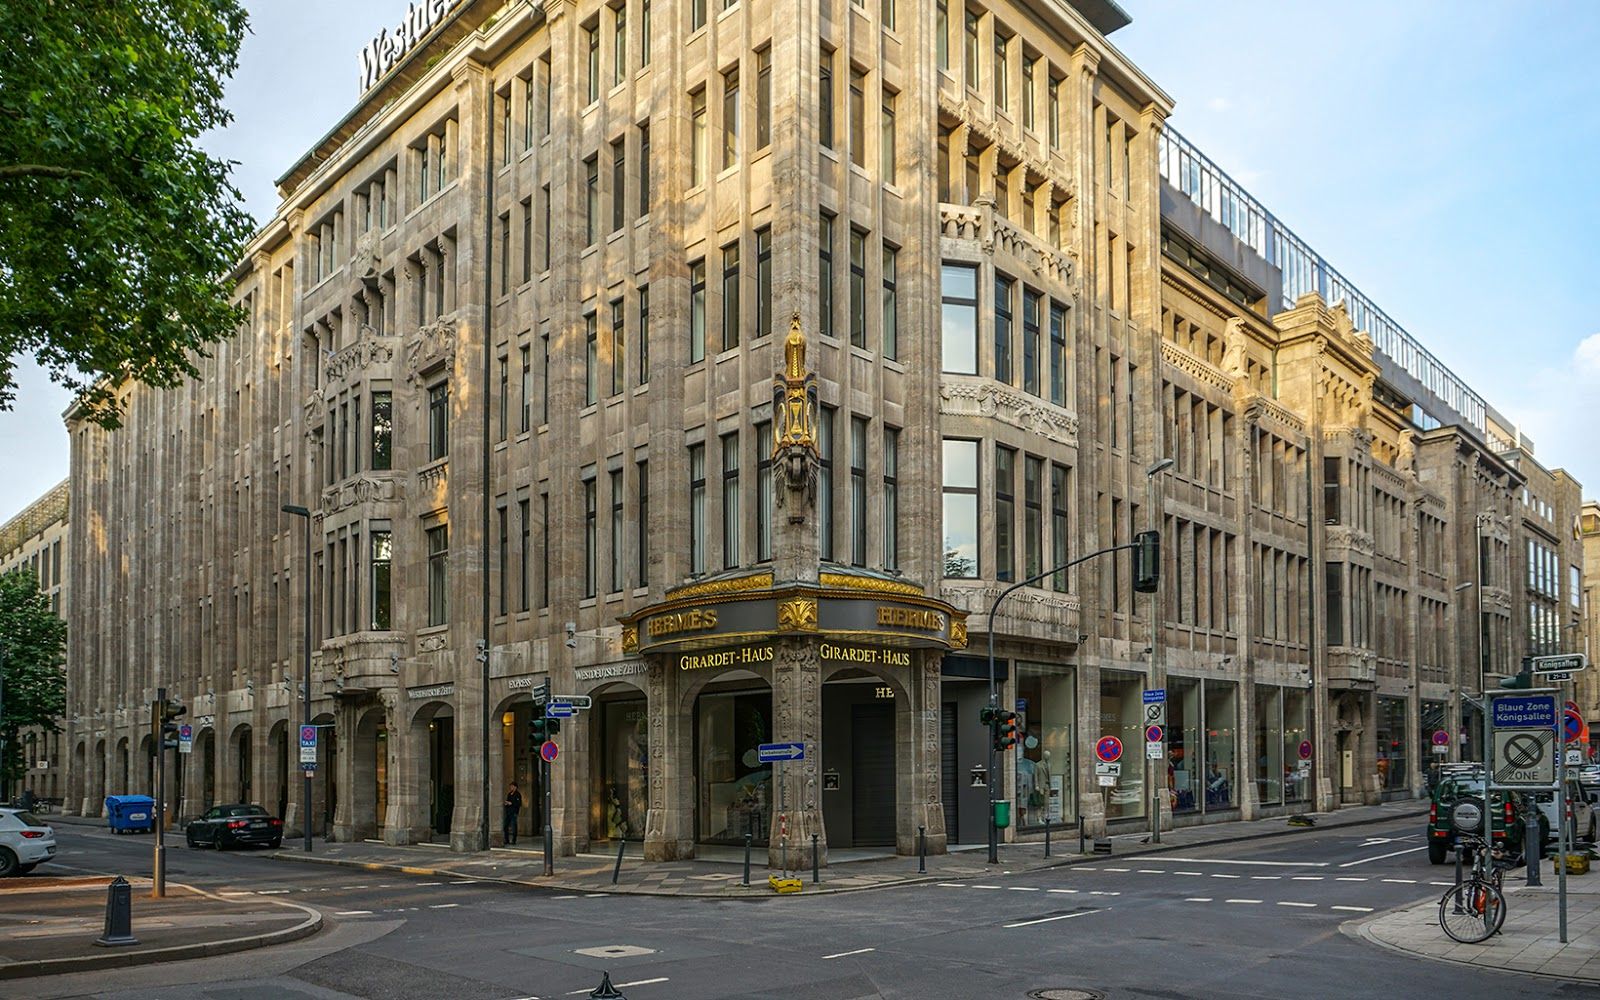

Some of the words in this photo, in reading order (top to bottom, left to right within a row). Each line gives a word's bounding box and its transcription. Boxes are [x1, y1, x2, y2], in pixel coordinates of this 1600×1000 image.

[622, 662, 649, 676] ZEITUN
[1538, 659, 1578, 669] Königsallee
[875, 687, 895, 698] HE
[1497, 703, 1524, 712] Blaue
[1526, 702, 1550, 711] Zone
[1496, 712, 1551, 722] Königsallee
[1508, 771, 1539, 781] ZONE
